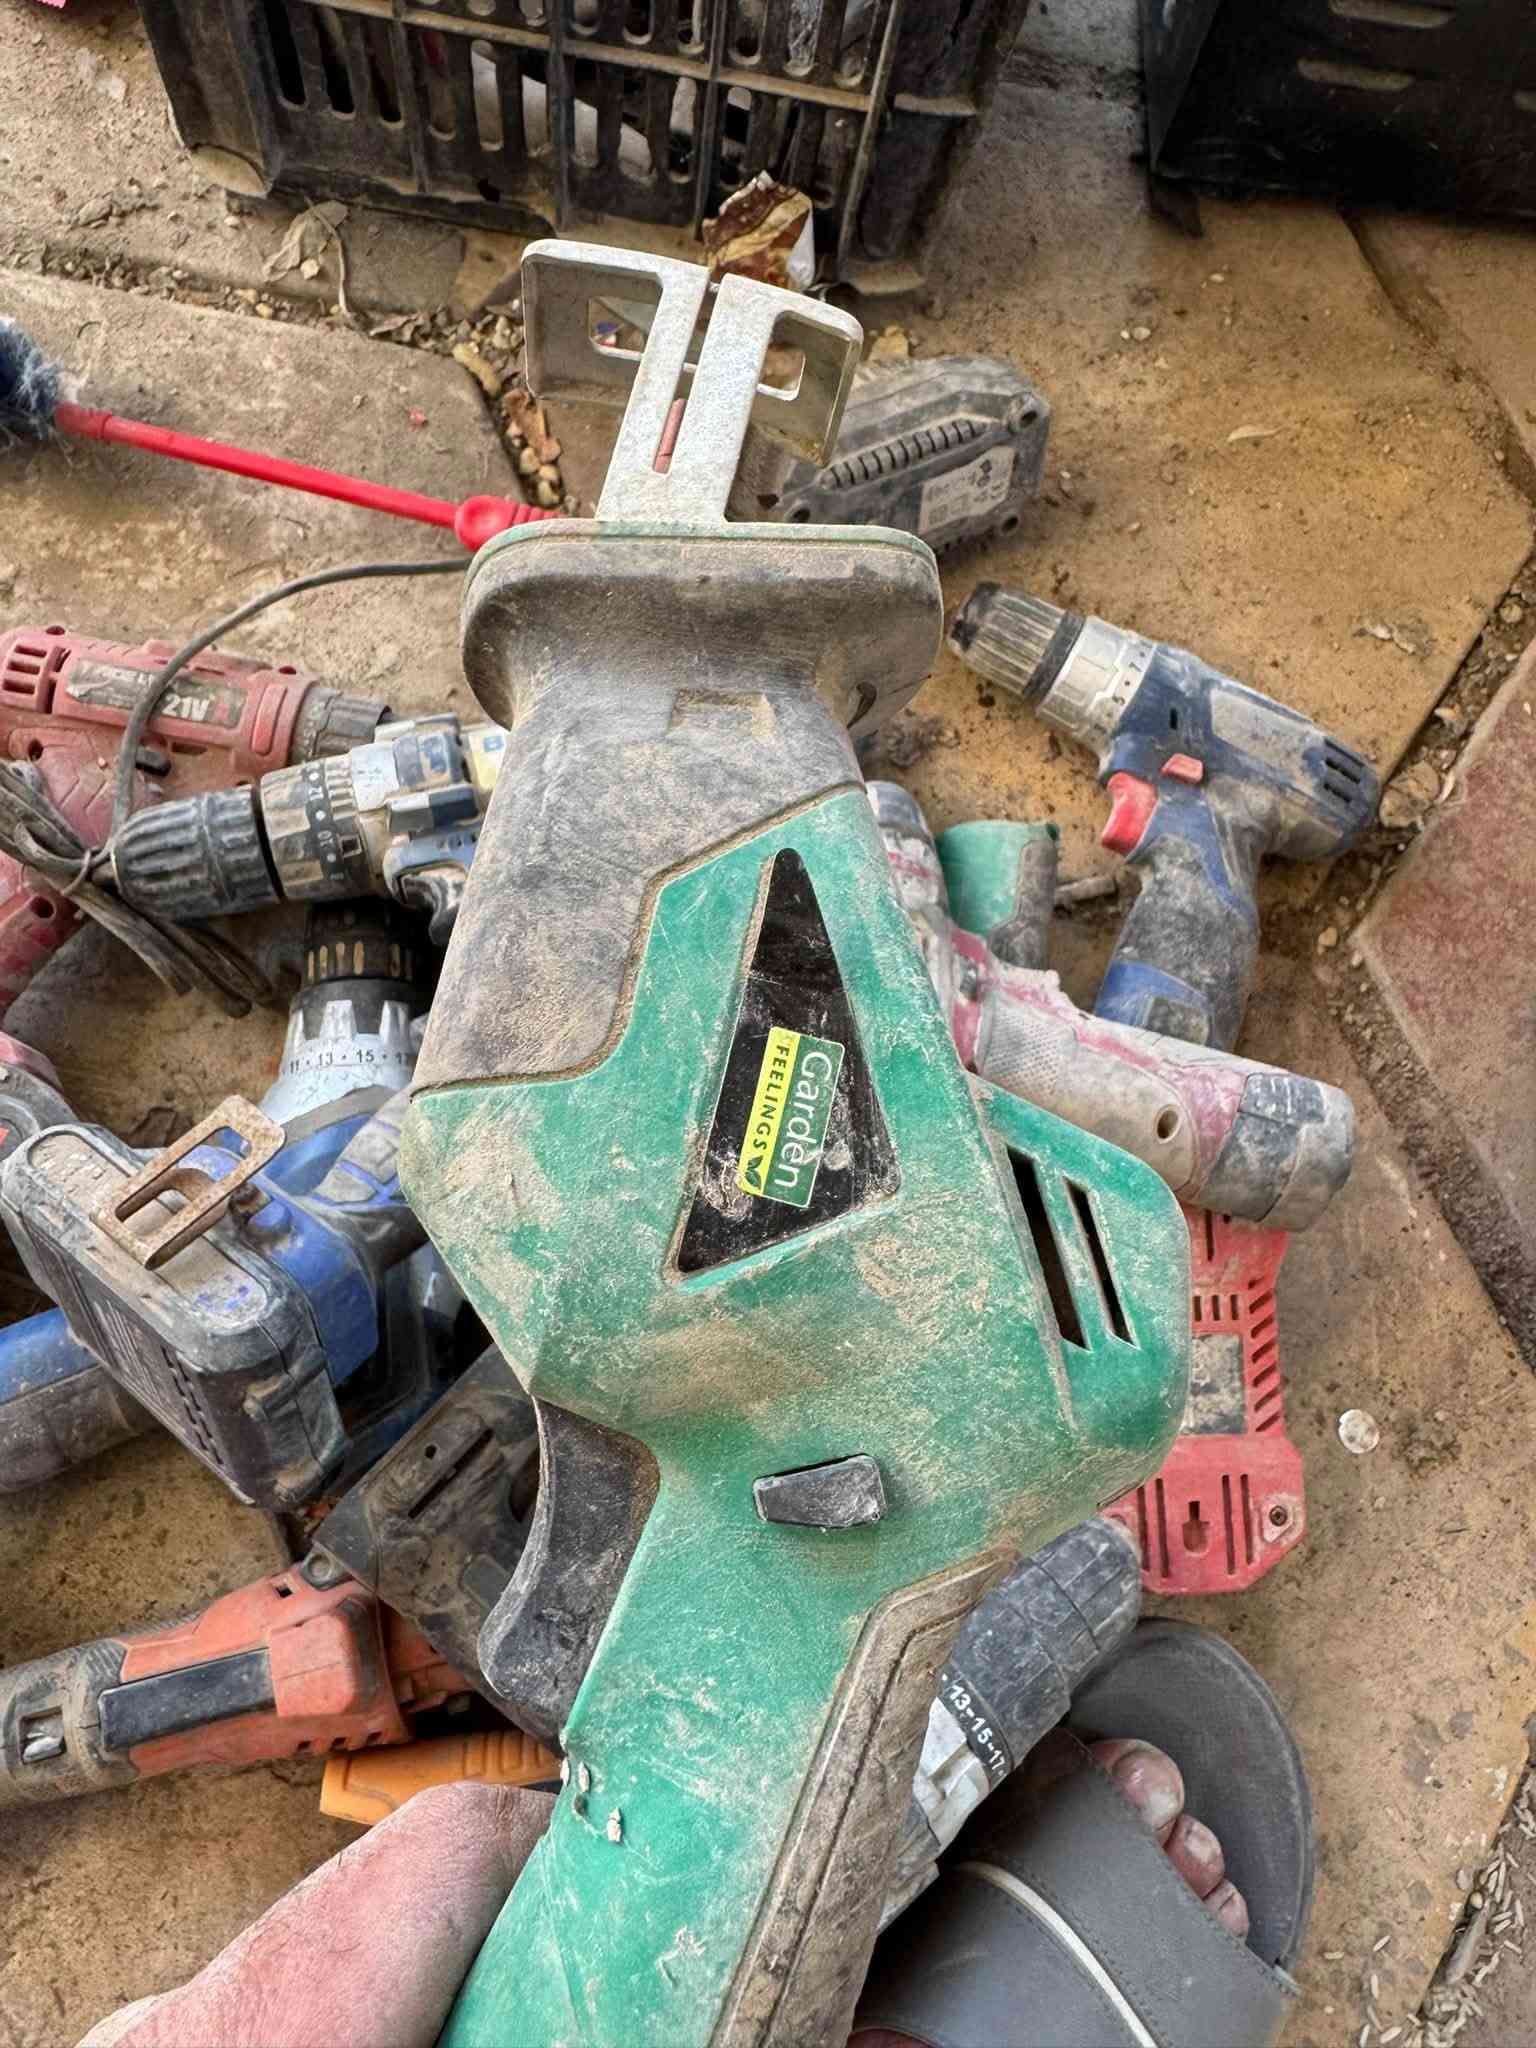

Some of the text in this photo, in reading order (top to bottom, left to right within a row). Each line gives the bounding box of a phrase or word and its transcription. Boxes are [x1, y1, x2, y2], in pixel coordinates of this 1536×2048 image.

[162, 693, 210, 722] 21V
[356, 1048, 376, 1064] 15
[752, 1044, 790, 1151] FEELINGS
[773, 1051, 833, 1188] Garden
